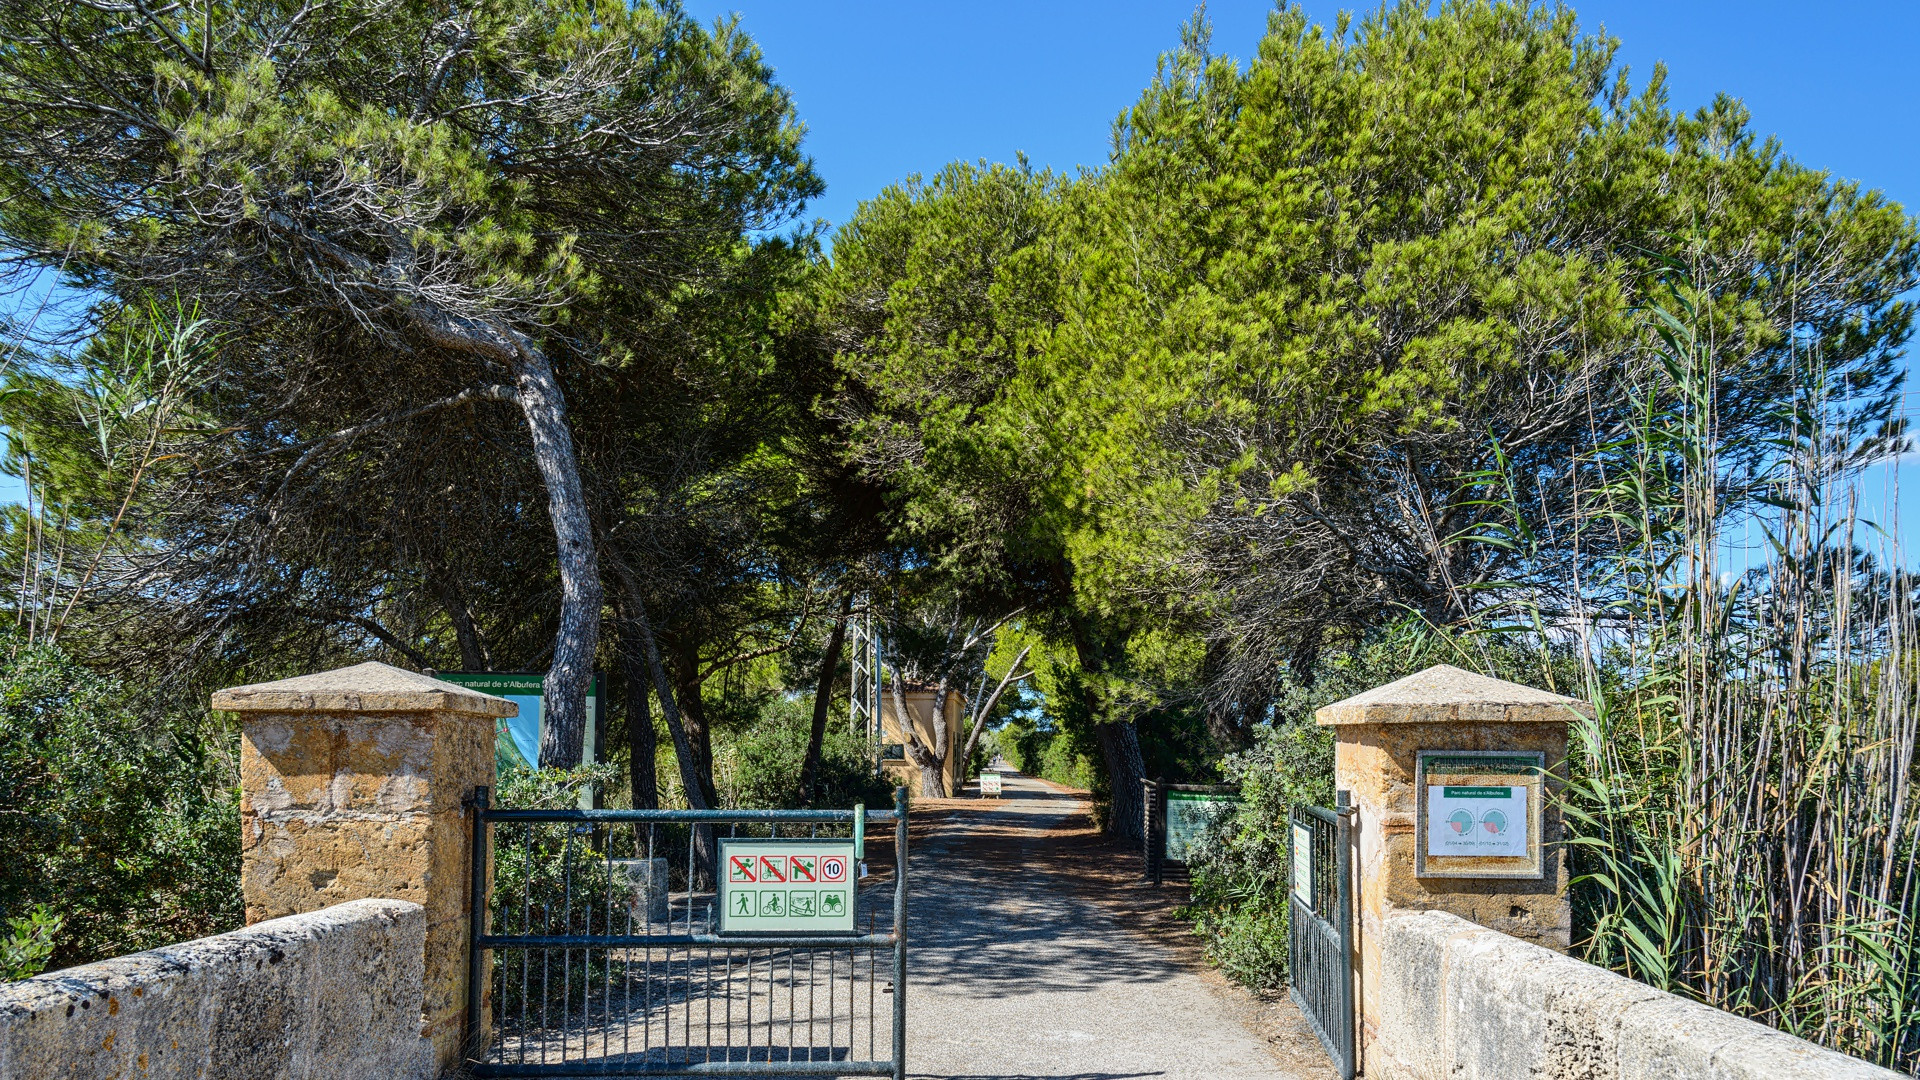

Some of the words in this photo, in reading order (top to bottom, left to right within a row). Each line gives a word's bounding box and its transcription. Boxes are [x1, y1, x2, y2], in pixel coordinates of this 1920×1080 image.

[464, 680, 491, 688] natural
[492, 680, 502, 688] de
[503, 680, 541, 689] s'Albufera
[826, 863, 840, 875] 10
